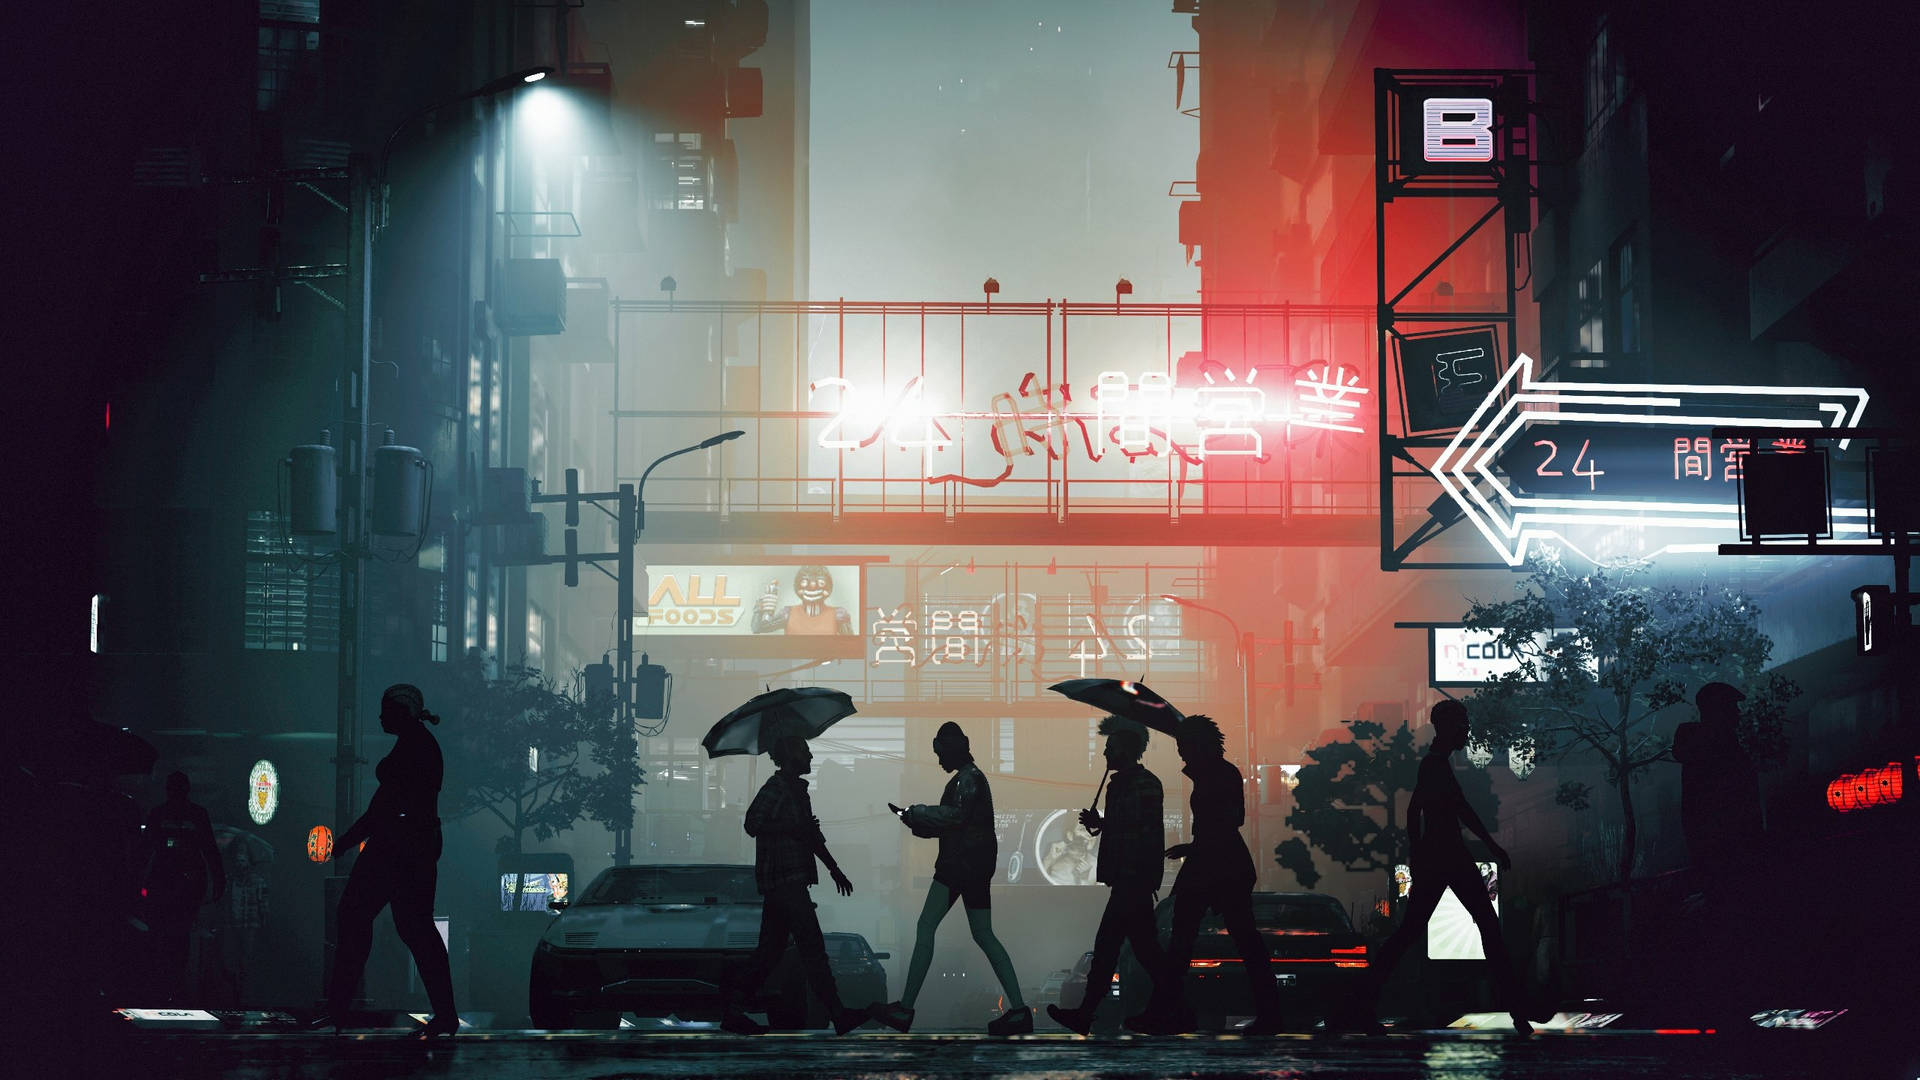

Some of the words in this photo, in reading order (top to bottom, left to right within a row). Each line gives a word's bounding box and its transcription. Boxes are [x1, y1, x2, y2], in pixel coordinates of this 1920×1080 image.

[1423, 98, 1493, 162] B
[1534, 438, 1605, 491] 24
[648, 575, 741, 606] ALL
[648, 609, 734, 624] FOODS
